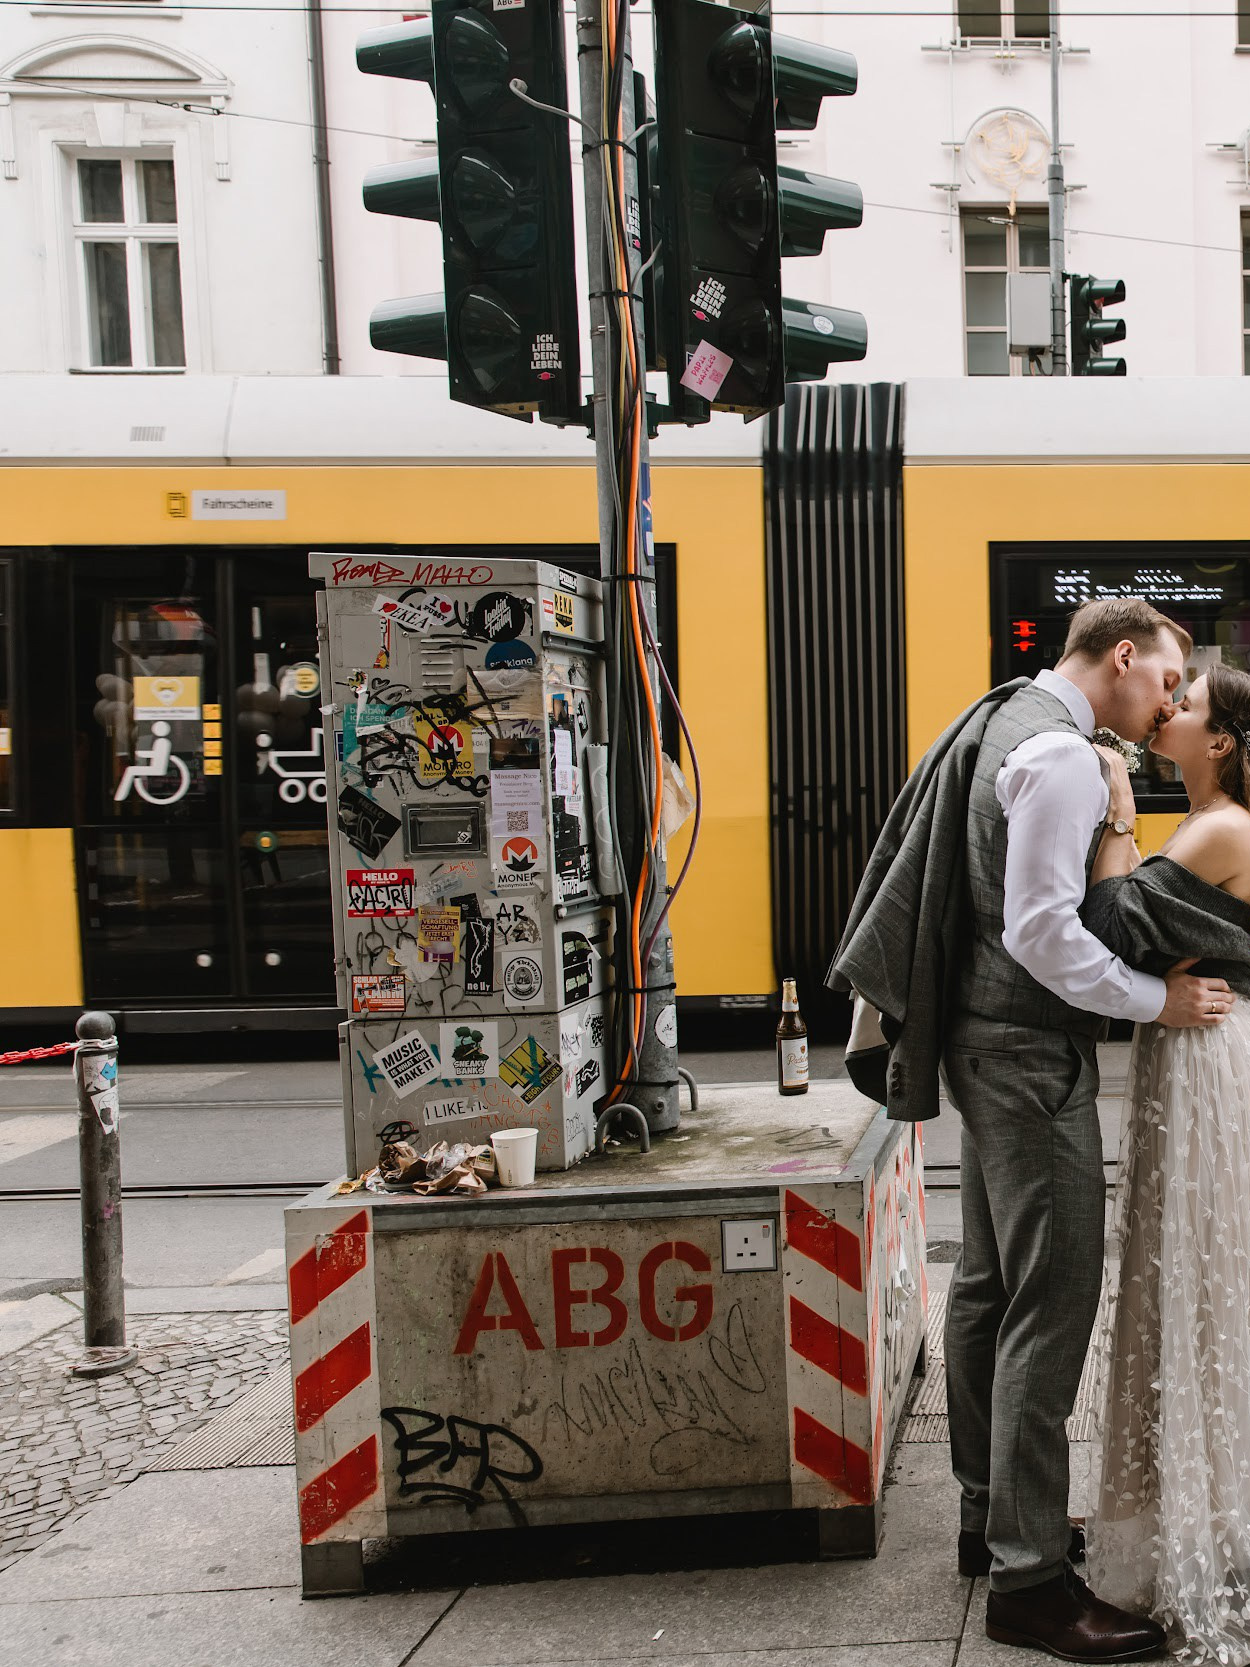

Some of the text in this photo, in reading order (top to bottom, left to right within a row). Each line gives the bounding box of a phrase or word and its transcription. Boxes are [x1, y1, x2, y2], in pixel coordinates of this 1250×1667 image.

[699, 281, 727, 304] LIEBE
[707, 277, 726, 293] ICH
[689, 293, 722, 319] LEBEN
[696, 288, 722, 310] DEIN
[536, 334, 554, 343] ICH
[532, 343, 560, 352] LIEBE
[533, 351, 559, 360] DEIN
[530, 360, 563, 369] LEBEN
[202, 498, 273, 509] Fahrscheine
[554, 593, 573, 615] REKA
[423, 604, 448, 622] PUSSY
[362, 872, 398, 881] HELLO
[382, 1037, 422, 1070] MUSIC
[397, 1058, 415, 1073] WHAT
[414, 1051, 427, 1063] YOU
[453, 1060, 487, 1068] SNEAKY
[393, 1057, 435, 1089] MAKE IT
[456, 1067, 485, 1076] BANKS
[434, 1101, 466, 1117] LIKE
[452, 1241, 716, 1356] ABG
